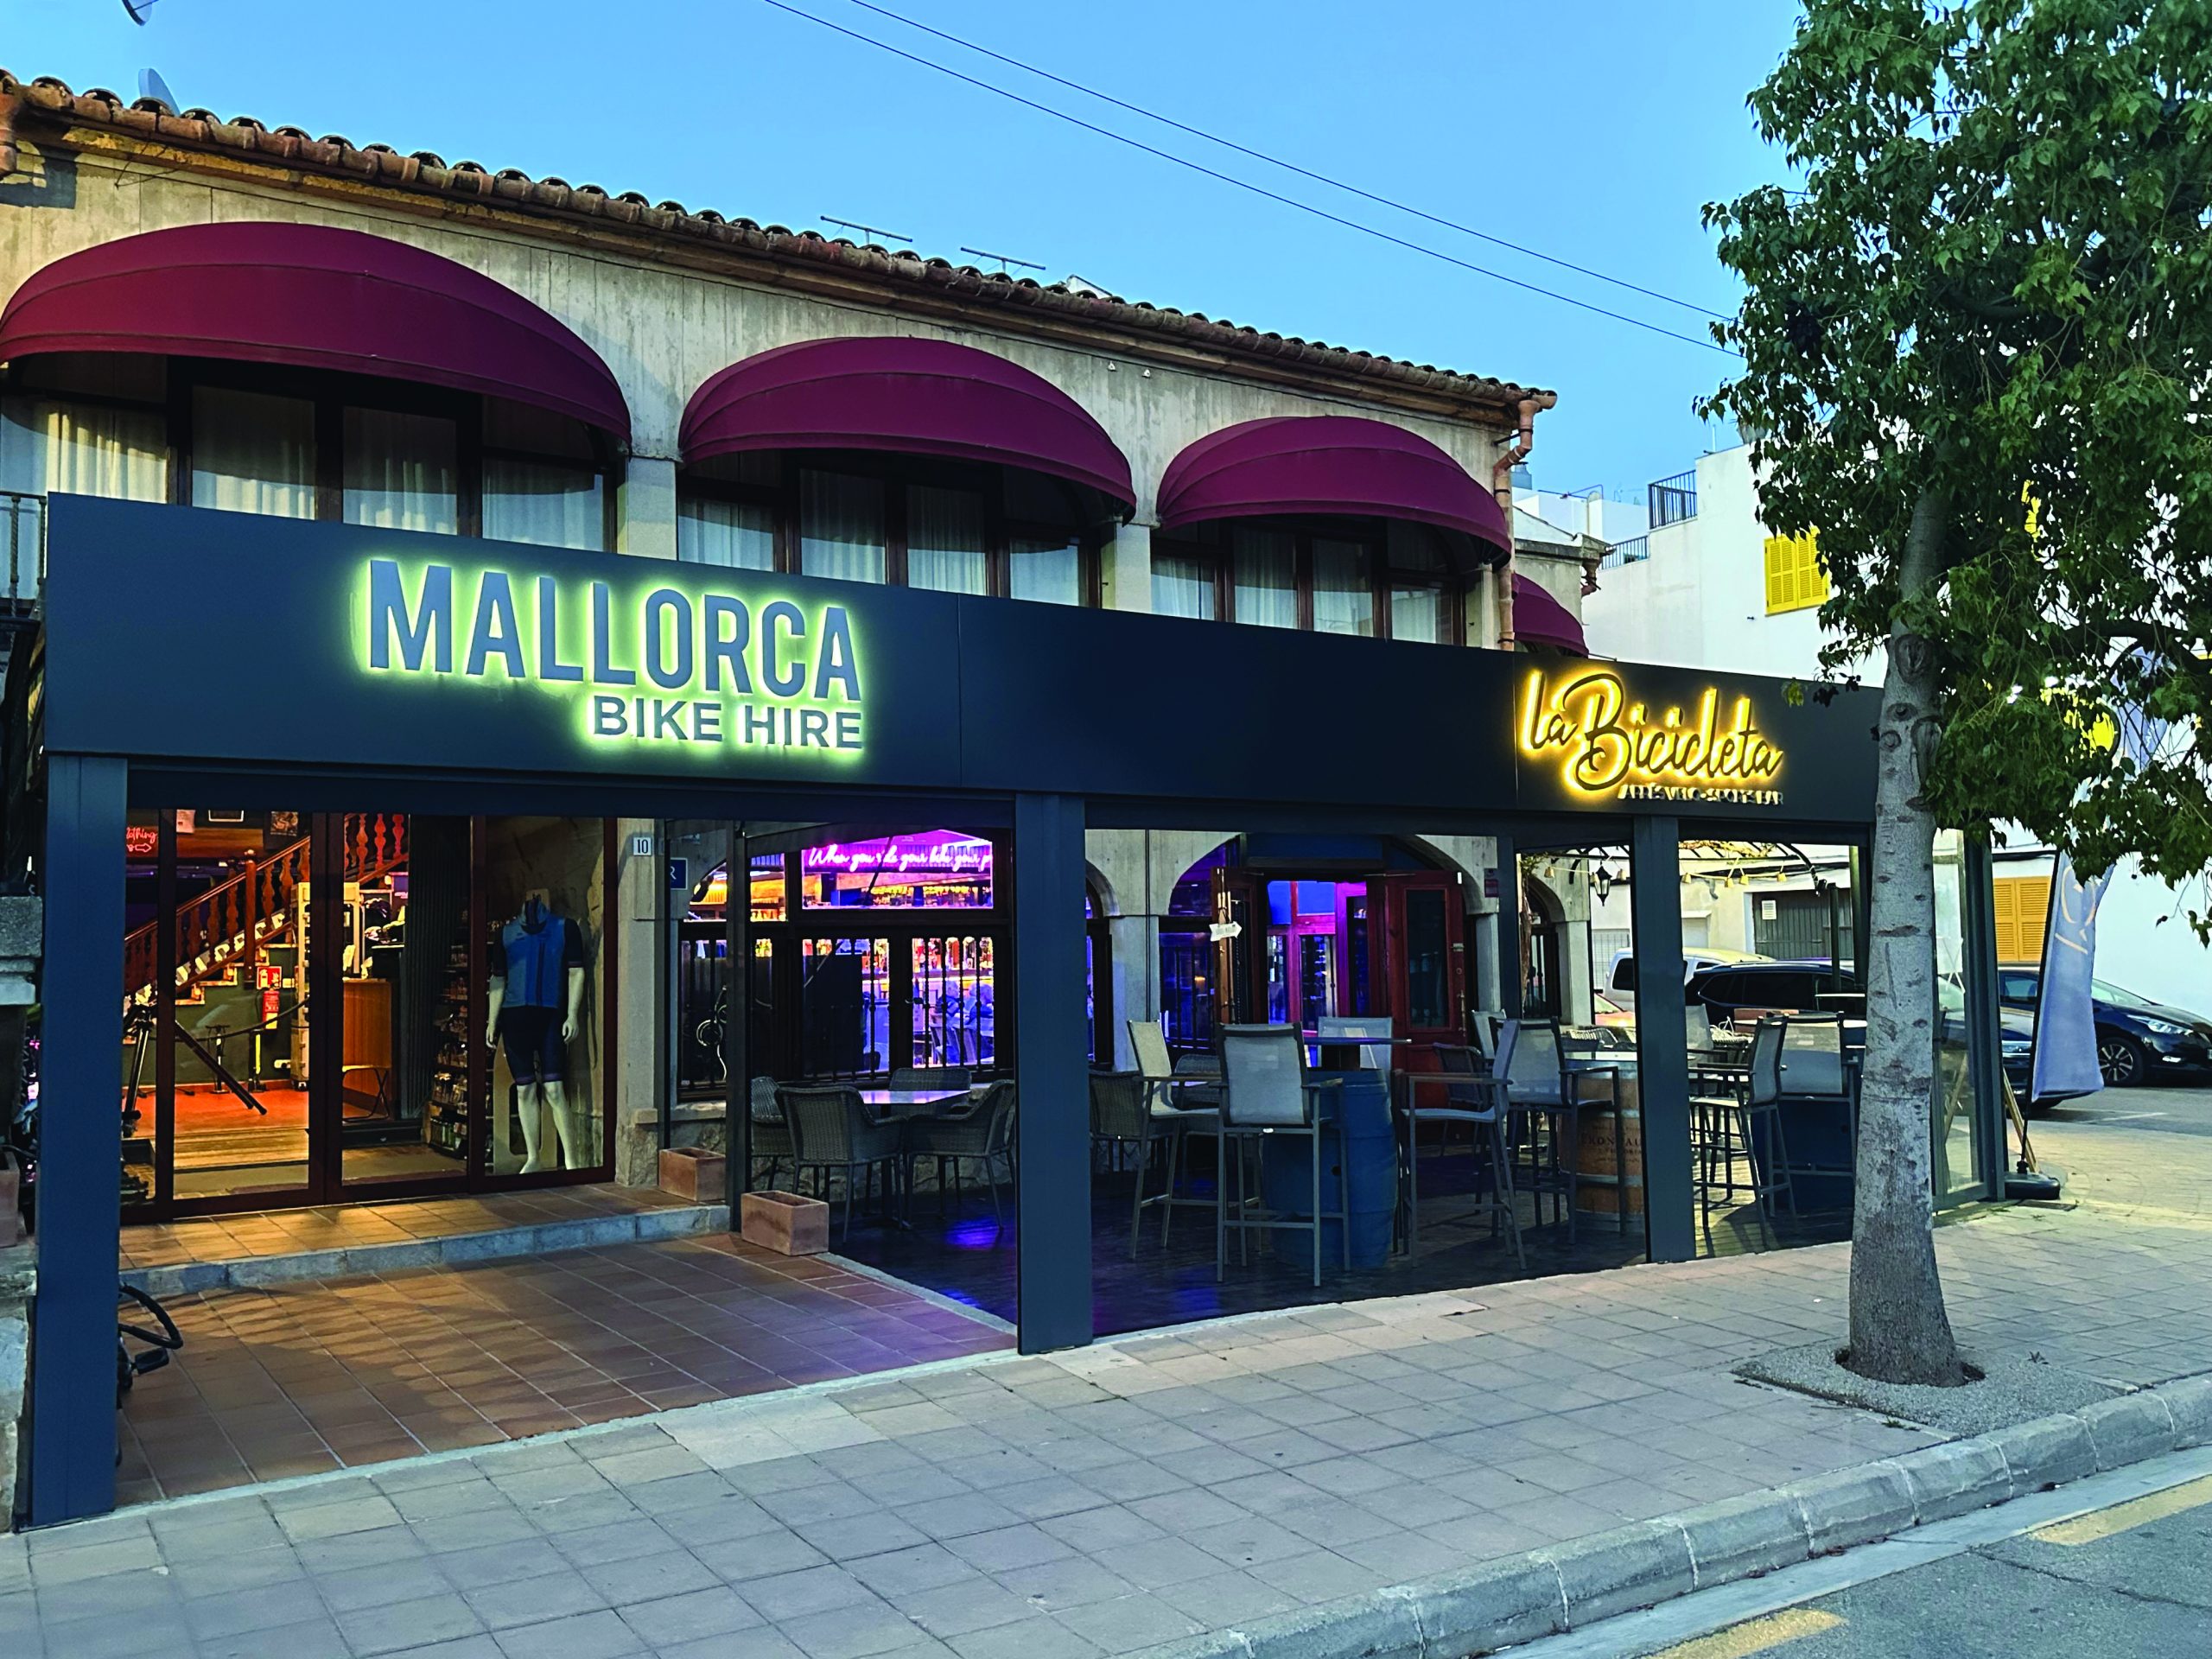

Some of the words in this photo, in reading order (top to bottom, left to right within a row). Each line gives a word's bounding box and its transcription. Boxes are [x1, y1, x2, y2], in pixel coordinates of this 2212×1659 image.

[369, 559, 861, 701] MALLORCA
[593, 695, 723, 743] BIKE
[744, 704, 863, 750] HIRE
[1562, 672, 1784, 791] Bicicleta
[637, 839, 649, 854] 10
[808, 843, 850, 867] When
